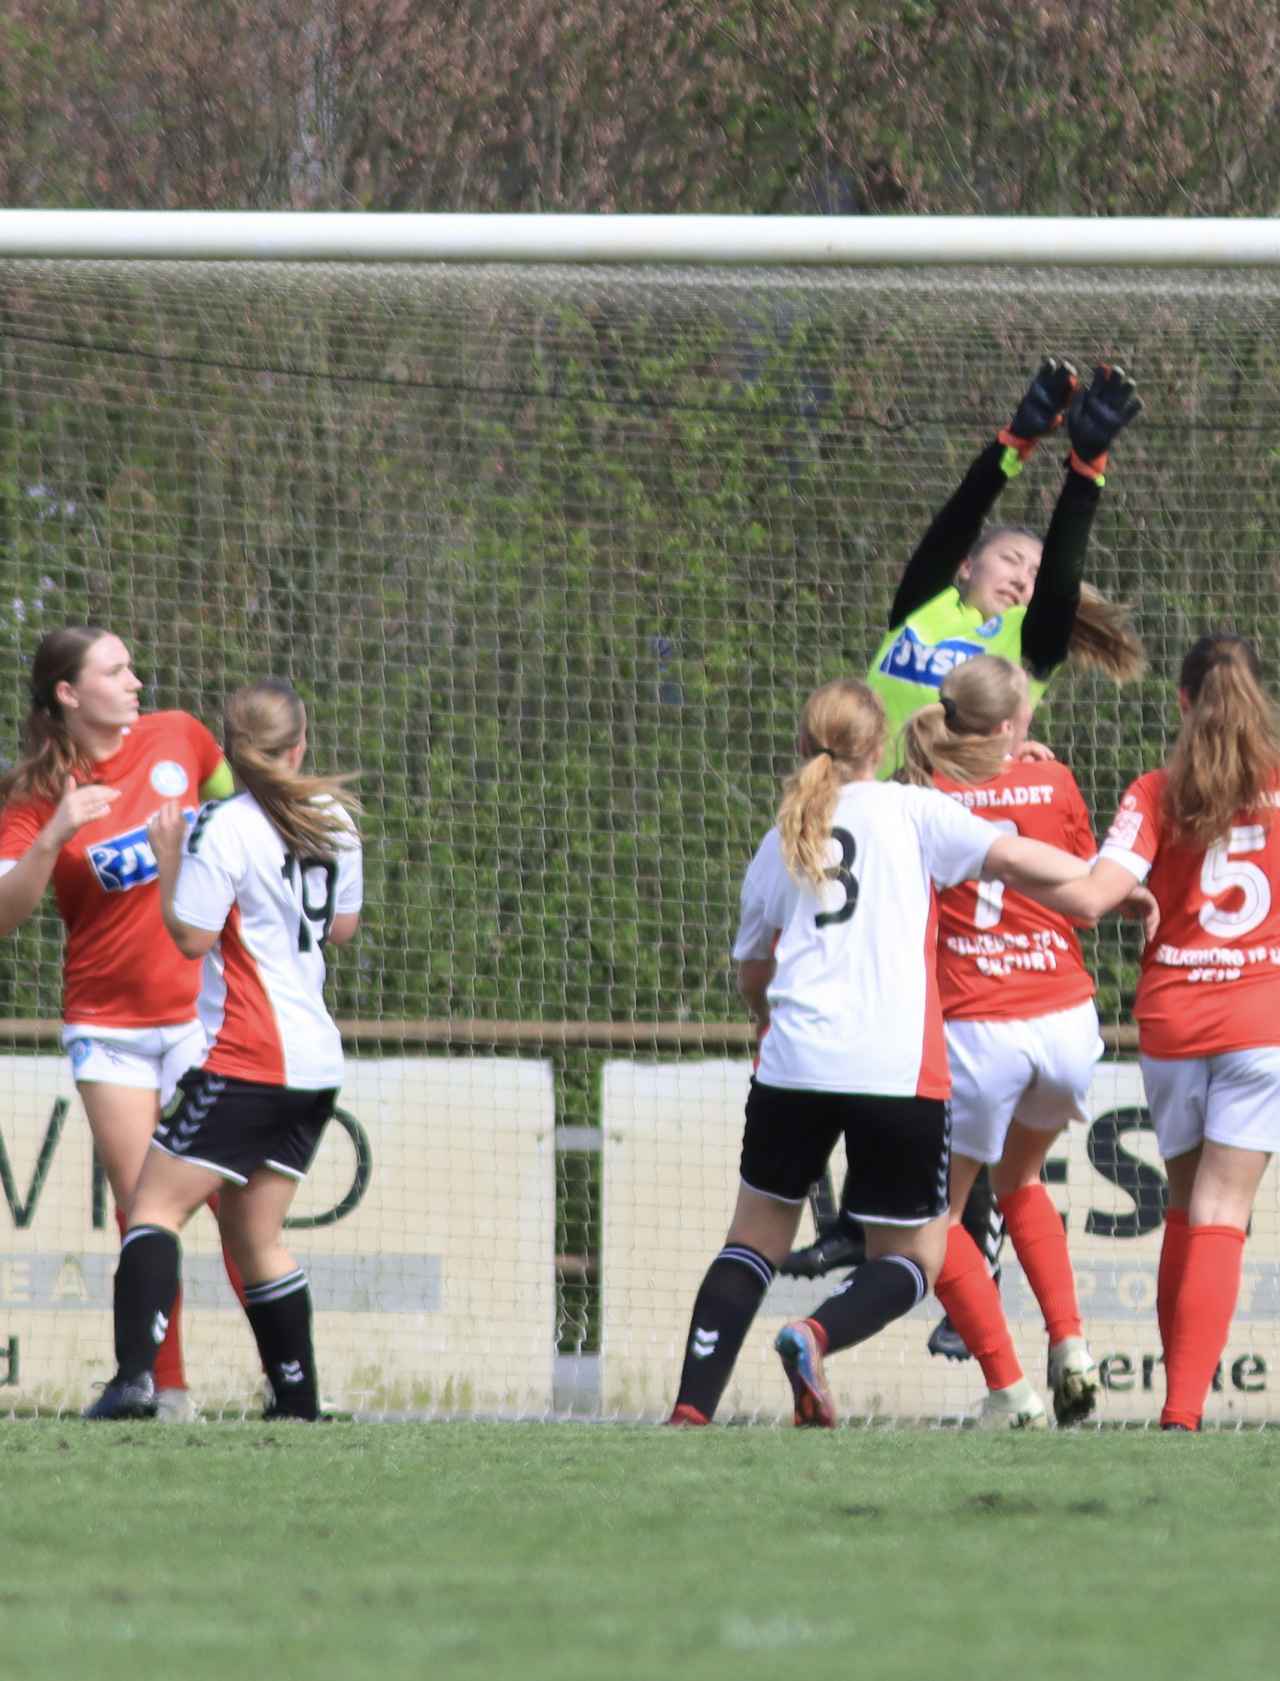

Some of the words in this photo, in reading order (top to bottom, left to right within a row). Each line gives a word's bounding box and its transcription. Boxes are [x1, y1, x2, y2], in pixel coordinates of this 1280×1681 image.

[281, 854, 338, 953] 19
[815, 826, 859, 928] 3
[1199, 824, 1272, 939] 5
